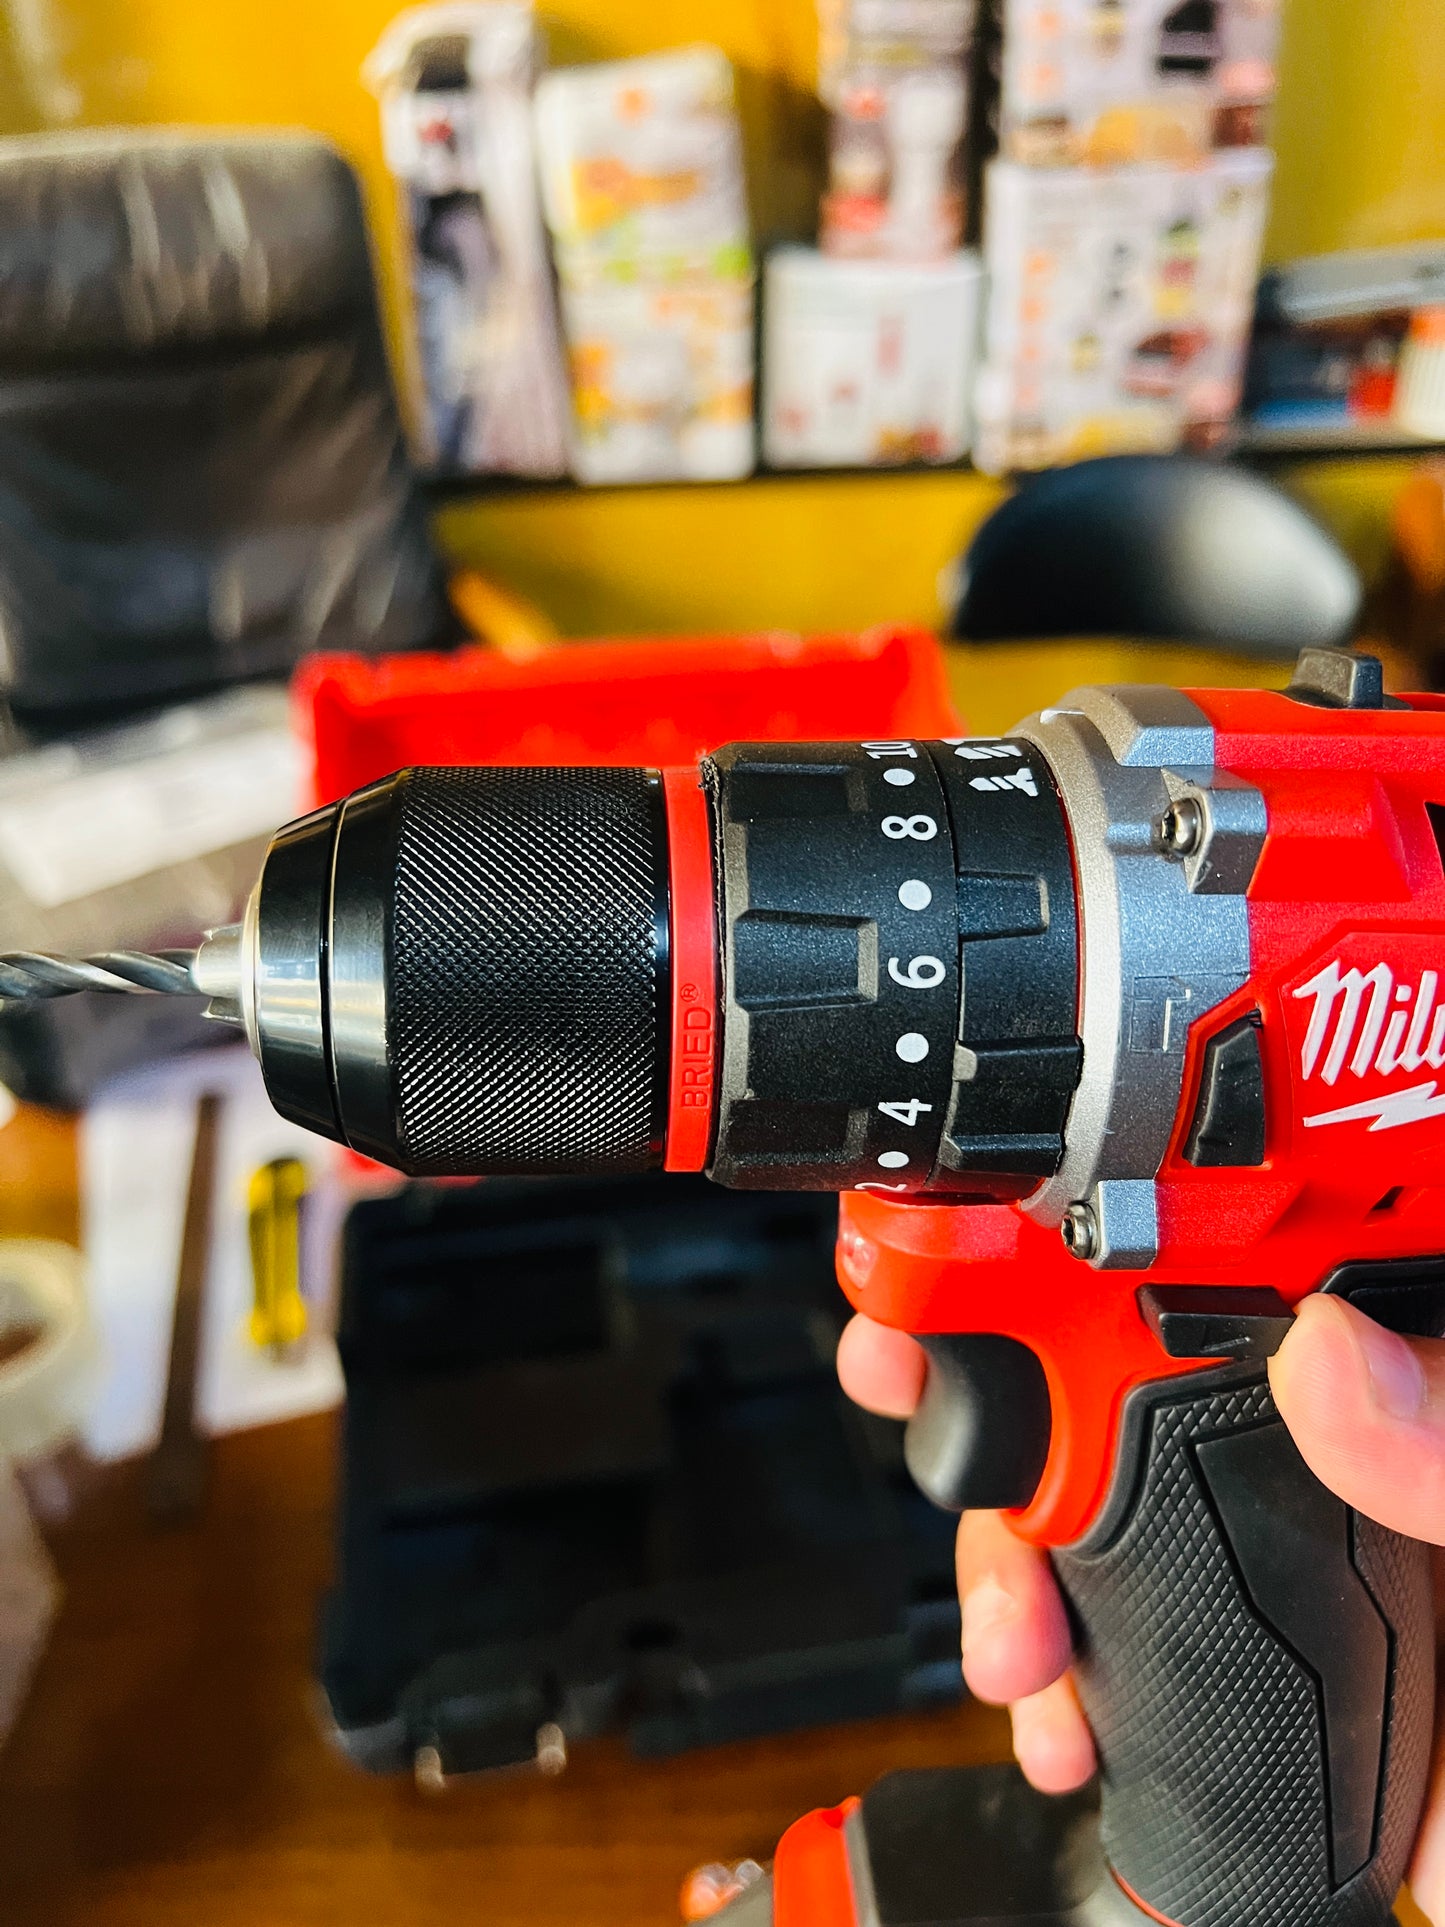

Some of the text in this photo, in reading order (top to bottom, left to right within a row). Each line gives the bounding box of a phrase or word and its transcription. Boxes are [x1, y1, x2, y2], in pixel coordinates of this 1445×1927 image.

[861, 741, 918, 760] 10
[881, 814, 938, 841] 8
[887, 955, 947, 989] 6
[878, 1098, 933, 1127] 4
